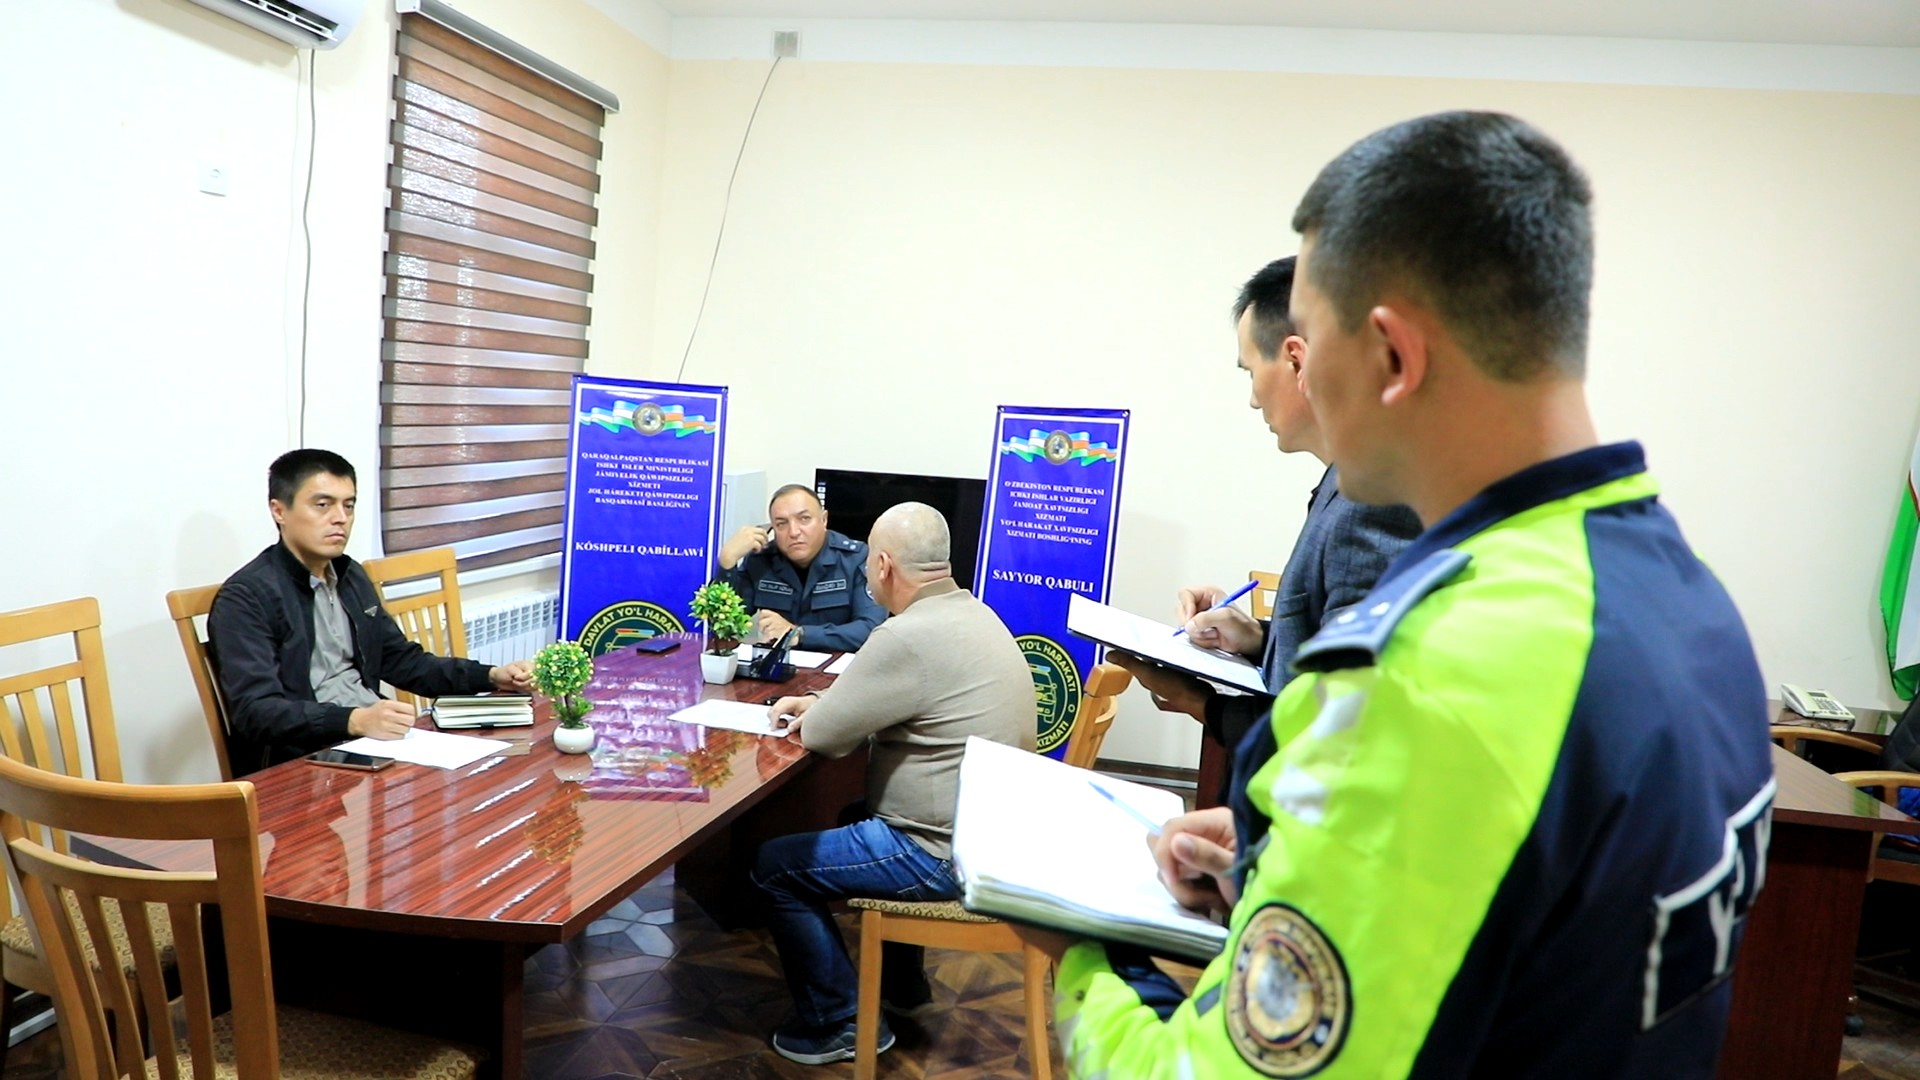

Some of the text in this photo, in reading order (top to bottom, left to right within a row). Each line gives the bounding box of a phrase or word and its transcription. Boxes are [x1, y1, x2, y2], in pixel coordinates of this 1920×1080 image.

[1013, 501, 1043, 510] JAMOAT
[1035, 513, 1066, 522] XIZMATI
[1006, 530, 1036, 538] XIZMATI
[575, 541, 634, 553] KÓSHPELI
[992, 569, 1094, 592] SAYYOR QABULI
[584, 606, 679, 646] DAVLAT YO'L HARAK
[1020, 640, 1077, 693] YO'L HARAKATI
